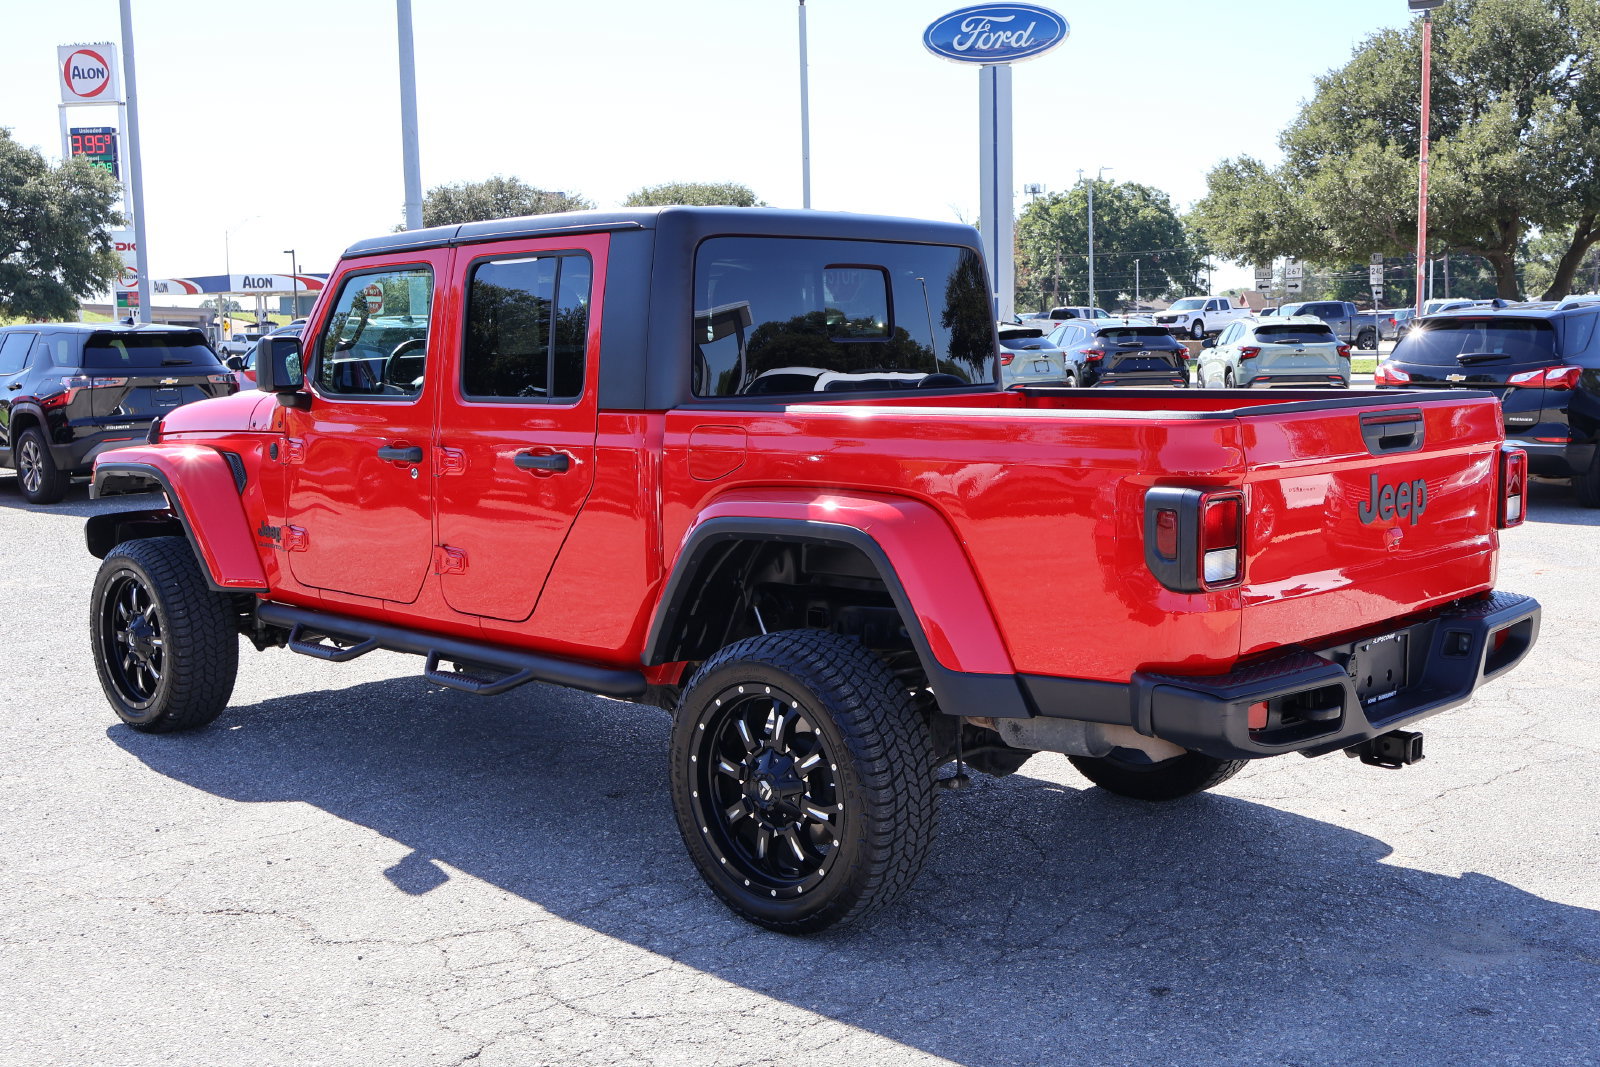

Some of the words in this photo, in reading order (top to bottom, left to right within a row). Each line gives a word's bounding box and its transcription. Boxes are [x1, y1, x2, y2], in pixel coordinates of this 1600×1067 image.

[952, 15, 1036, 51] Ford
[72, 65, 105, 79] ALON
[1287, 267, 1301, 275] 267
[1371, 267, 1383, 275] 240
[243, 275, 273, 289] ALON
[1358, 473, 1428, 525] Jeep
[258, 520, 282, 542] Jeep
